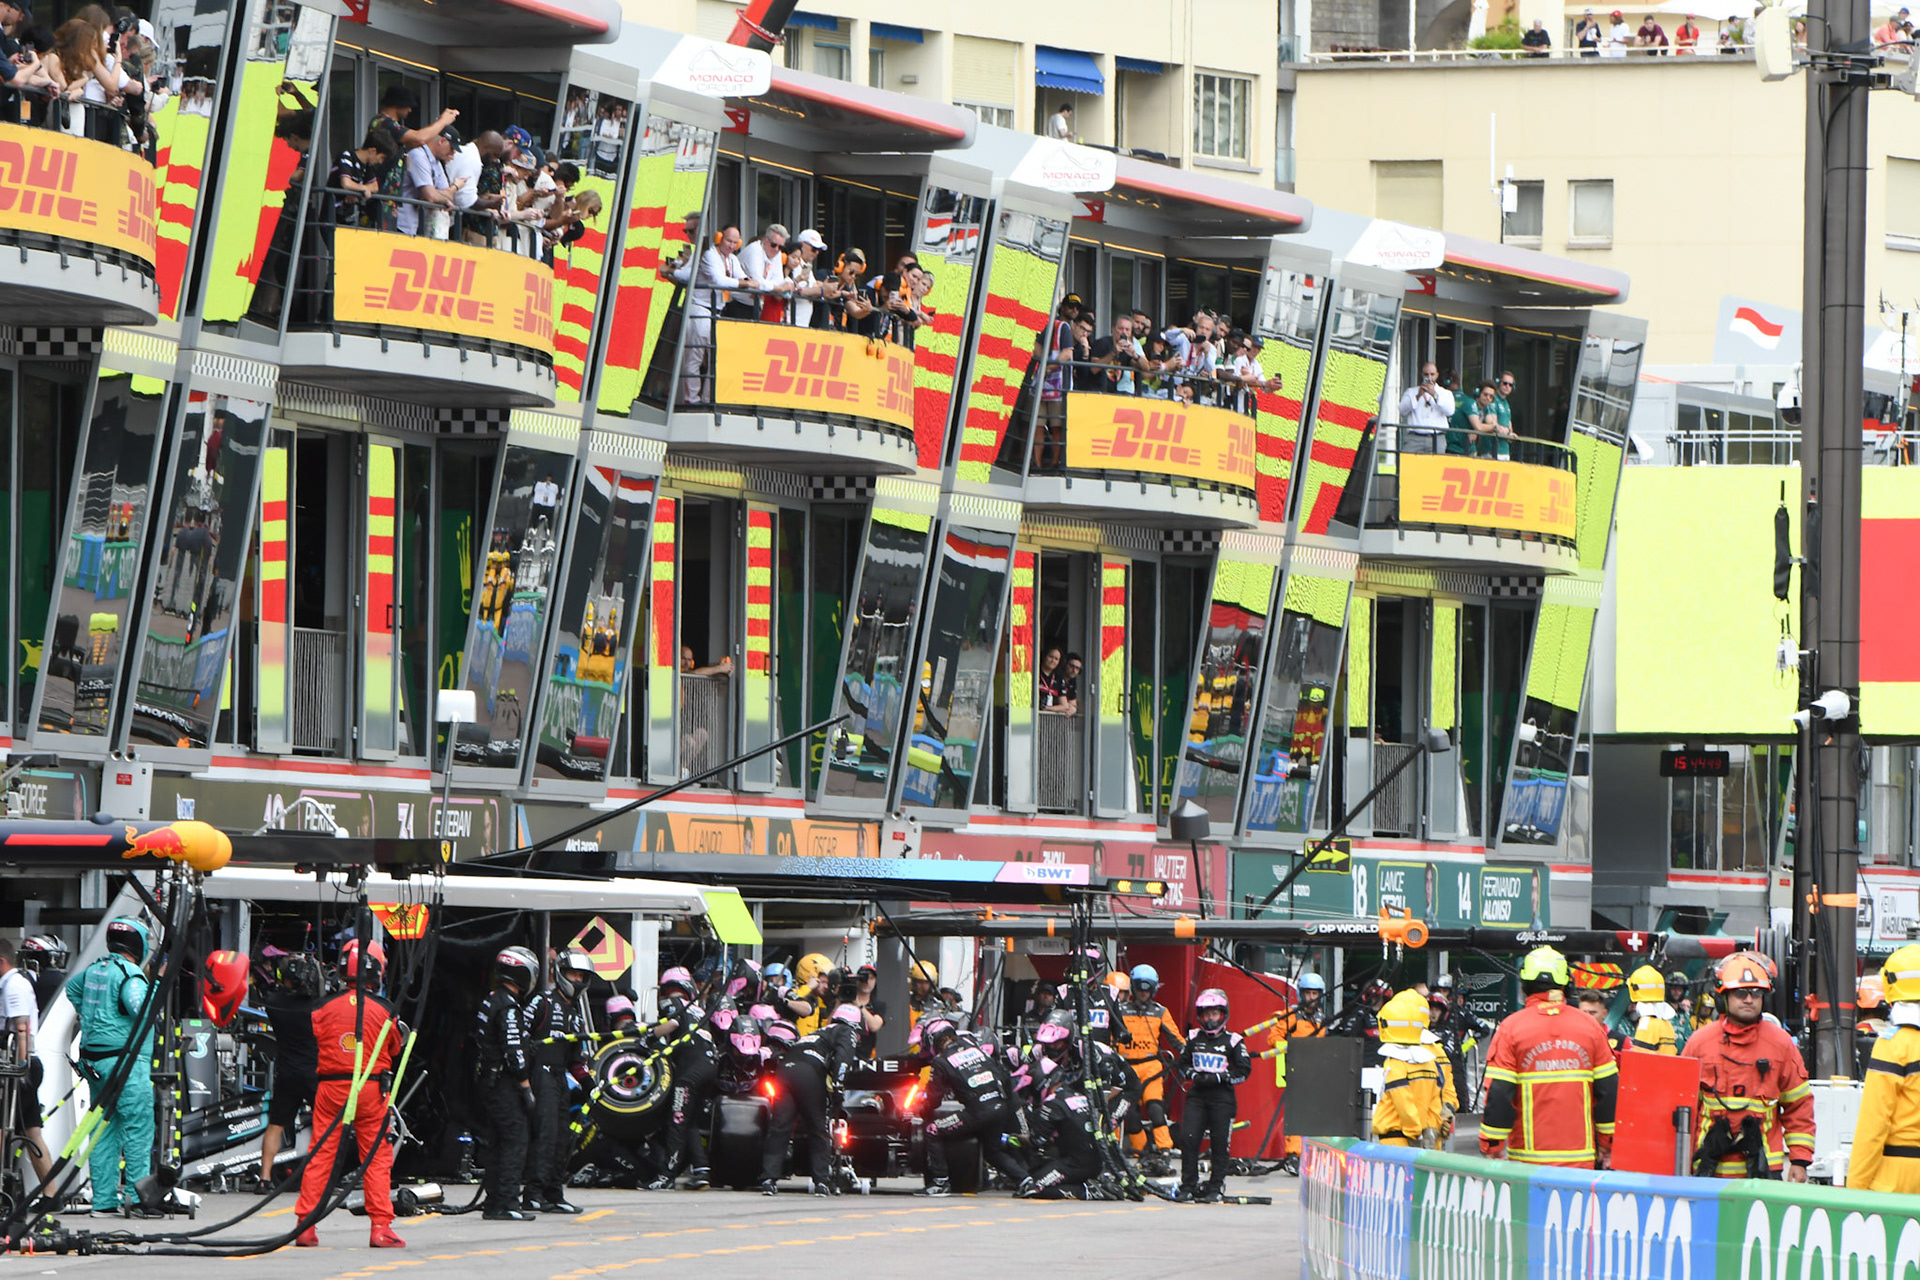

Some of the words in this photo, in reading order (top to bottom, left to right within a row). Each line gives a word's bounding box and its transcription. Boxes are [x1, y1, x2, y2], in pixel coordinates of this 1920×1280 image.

[689, 74, 753, 83] MONACO
[0, 140, 83, 224] DHL
[1042, 172, 1101, 181] MONACO
[388, 249, 478, 321] DHL
[764, 340, 847, 400] DHL
[1111, 408, 1187, 464] DHL
[1440, 467, 1511, 518] DHL
[1674, 755, 1687, 770] 15
[433, 809, 472, 838] ETEBAN
[1037, 868, 1072, 879] BWT
[1380, 870, 1405, 892] LANCE
[1352, 864, 1368, 918] 18
[1457, 872, 1472, 920] 14
[1482, 876, 1521, 898] FERNANDO
[1483, 899, 1512, 921] ALONSO
[1319, 924, 1336, 934] DP
[1336, 923, 1379, 934] WORLD
[1516, 930, 1535, 945] Alfa
[1193, 1053, 1224, 1069] BWT
[1535, 1058, 1580, 1071] MONACO
[228, 1117, 261, 1135] Syntium
